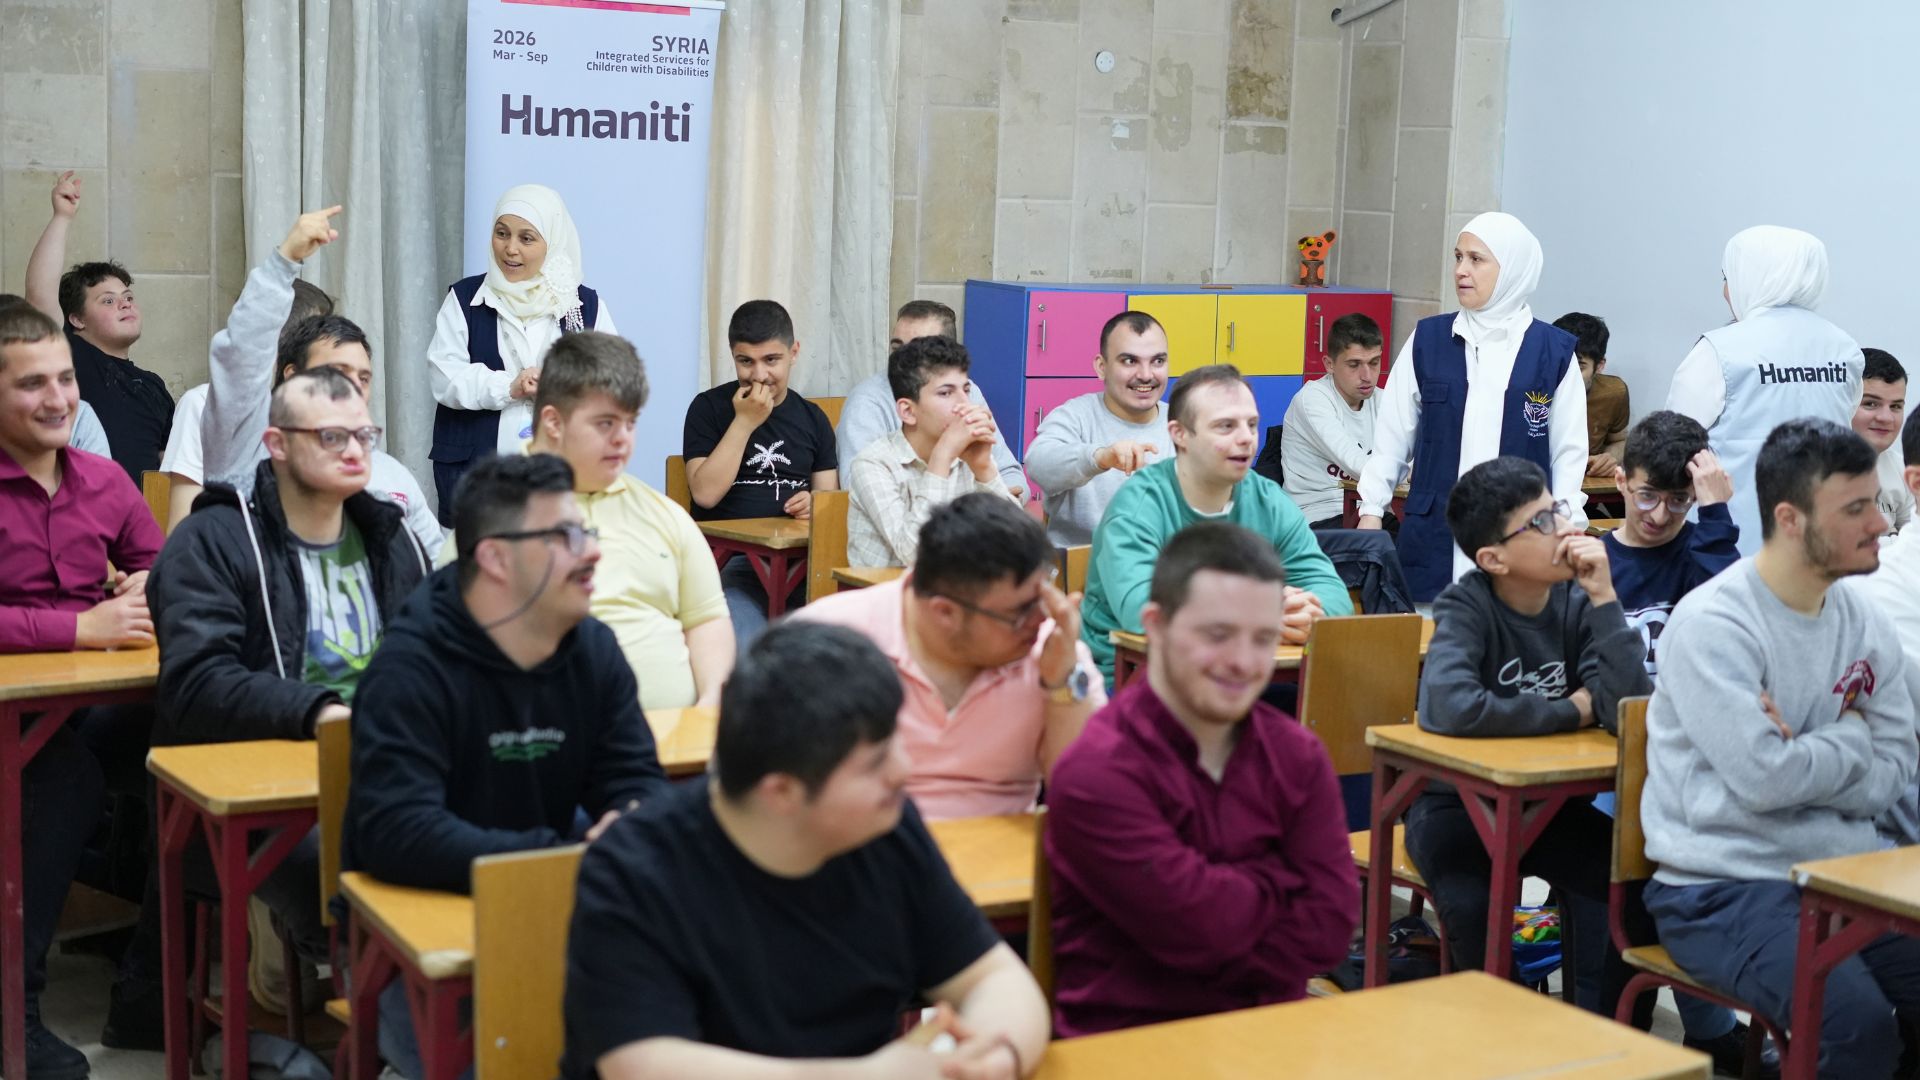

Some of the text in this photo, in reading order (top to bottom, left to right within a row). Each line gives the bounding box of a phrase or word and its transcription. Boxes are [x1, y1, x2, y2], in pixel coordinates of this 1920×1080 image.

[493, 29, 536, 46] 2026
[652, 36, 710, 55] SYRIA
[493, 49, 516, 60] Mar
[527, 51, 548, 64] Sep
[596, 51, 710, 66] Integrated Services for
[586, 61, 709, 77] Children with Disabilities
[501, 93, 690, 142] Humaniti
[1758, 361, 1847, 384] Humaniti
